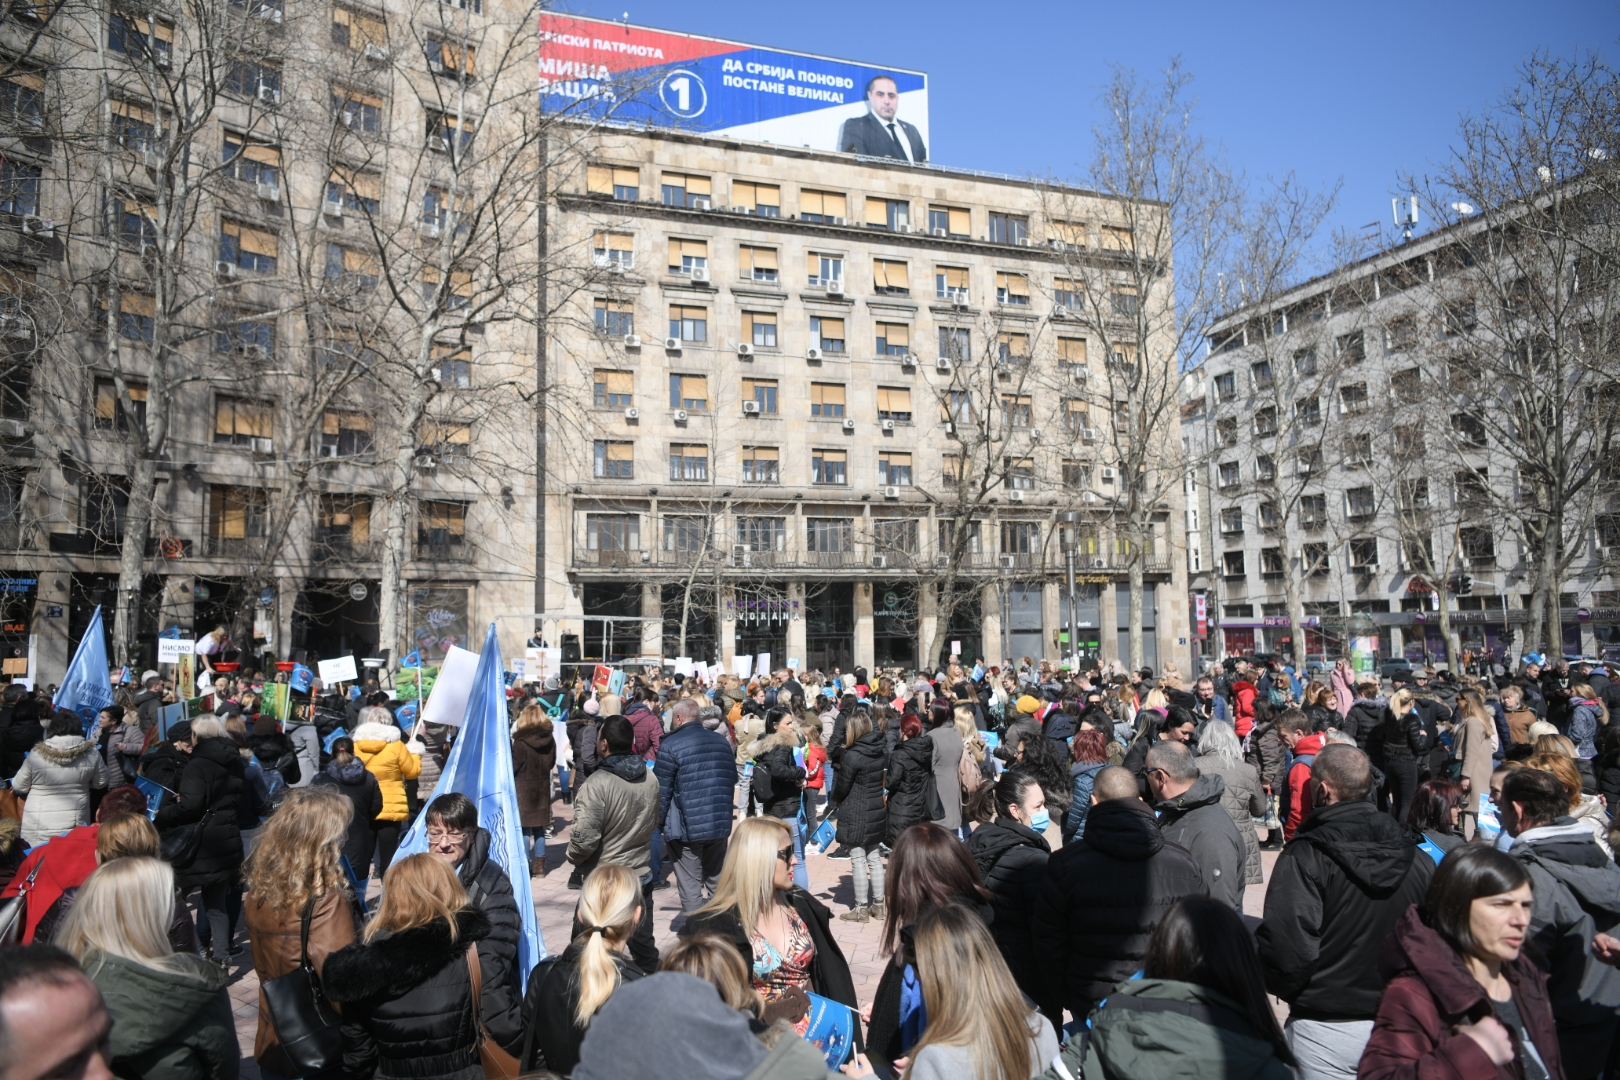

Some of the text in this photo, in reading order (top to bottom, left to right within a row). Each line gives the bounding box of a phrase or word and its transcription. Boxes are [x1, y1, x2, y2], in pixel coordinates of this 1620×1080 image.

[593, 38, 664, 59] ПАТРИОТА
[722, 58, 854, 89] ДА СРБИЈА ПОНОВО
[669, 77, 690, 111] 1
[723, 75, 844, 104] ПОСТАНЕ ВЕЛИКА!
[726, 611, 800, 621] DVORANA
[162, 644, 191, 652] НИСМО
